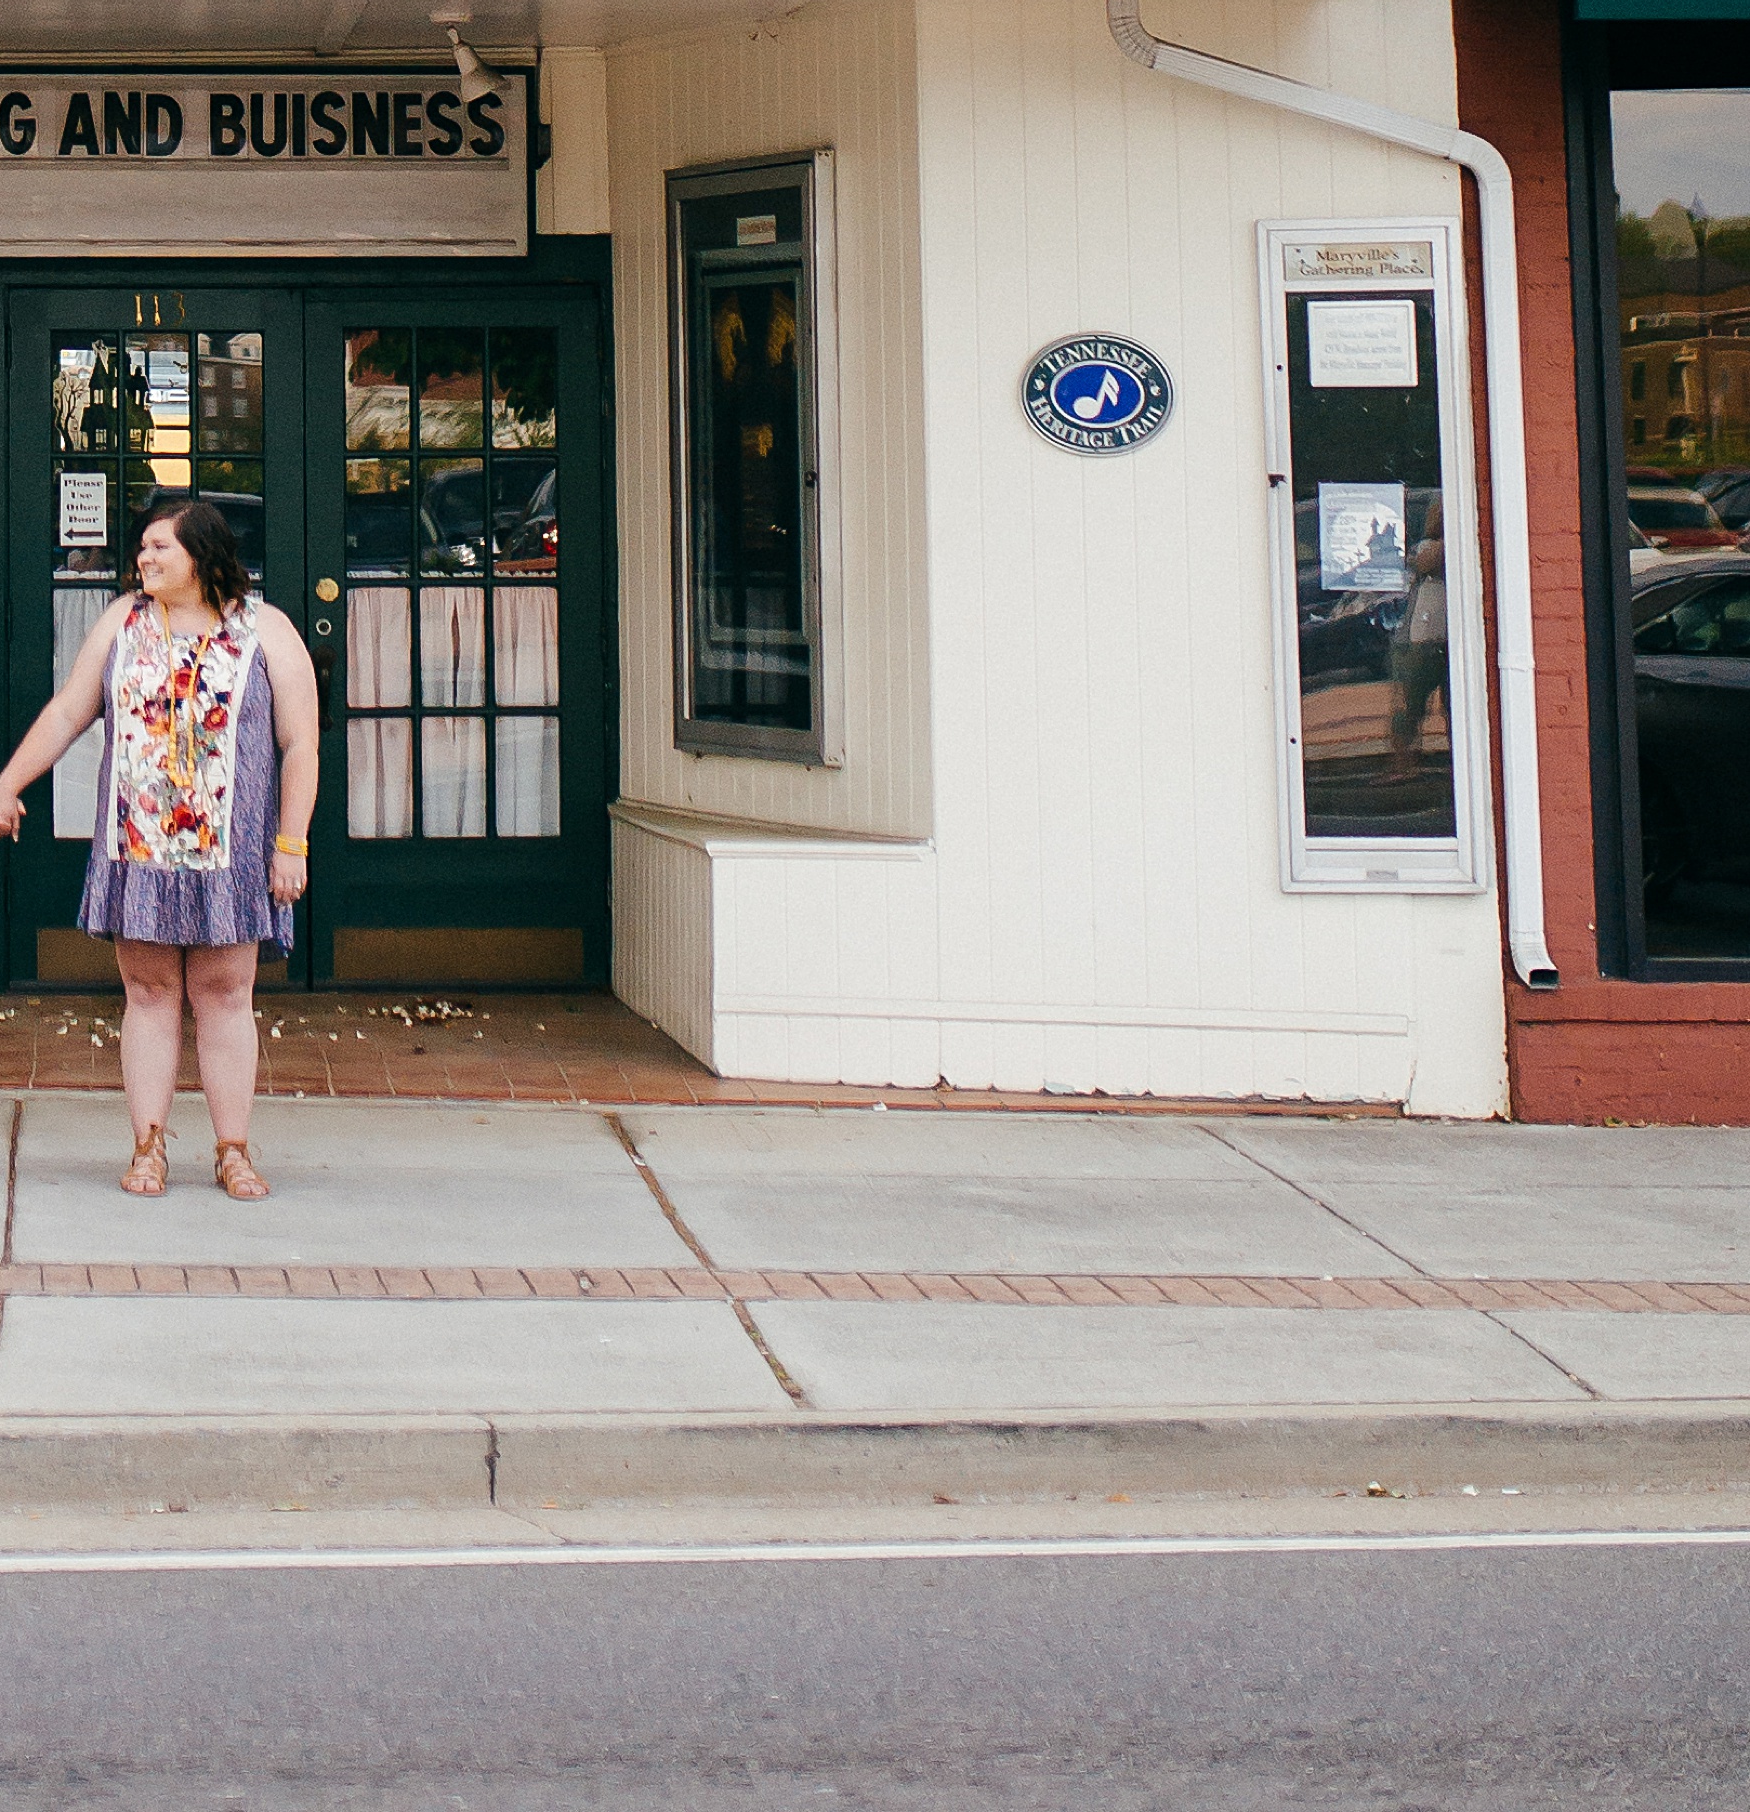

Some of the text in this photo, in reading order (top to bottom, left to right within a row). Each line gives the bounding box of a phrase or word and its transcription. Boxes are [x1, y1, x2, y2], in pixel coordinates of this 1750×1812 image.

[58, 91, 184, 156] AND
[209, 90, 506, 157] BUISNESS
[1300, 263, 1374, 276] Gathering
[1316, 250, 1400, 266] Maryville's
[134, 291, 185, 328] 113
[1039, 342, 1152, 379] TENNESSEE
[1029, 394, 1165, 447] HERITAGE TRAIL
[66, 503, 101, 511] Other
